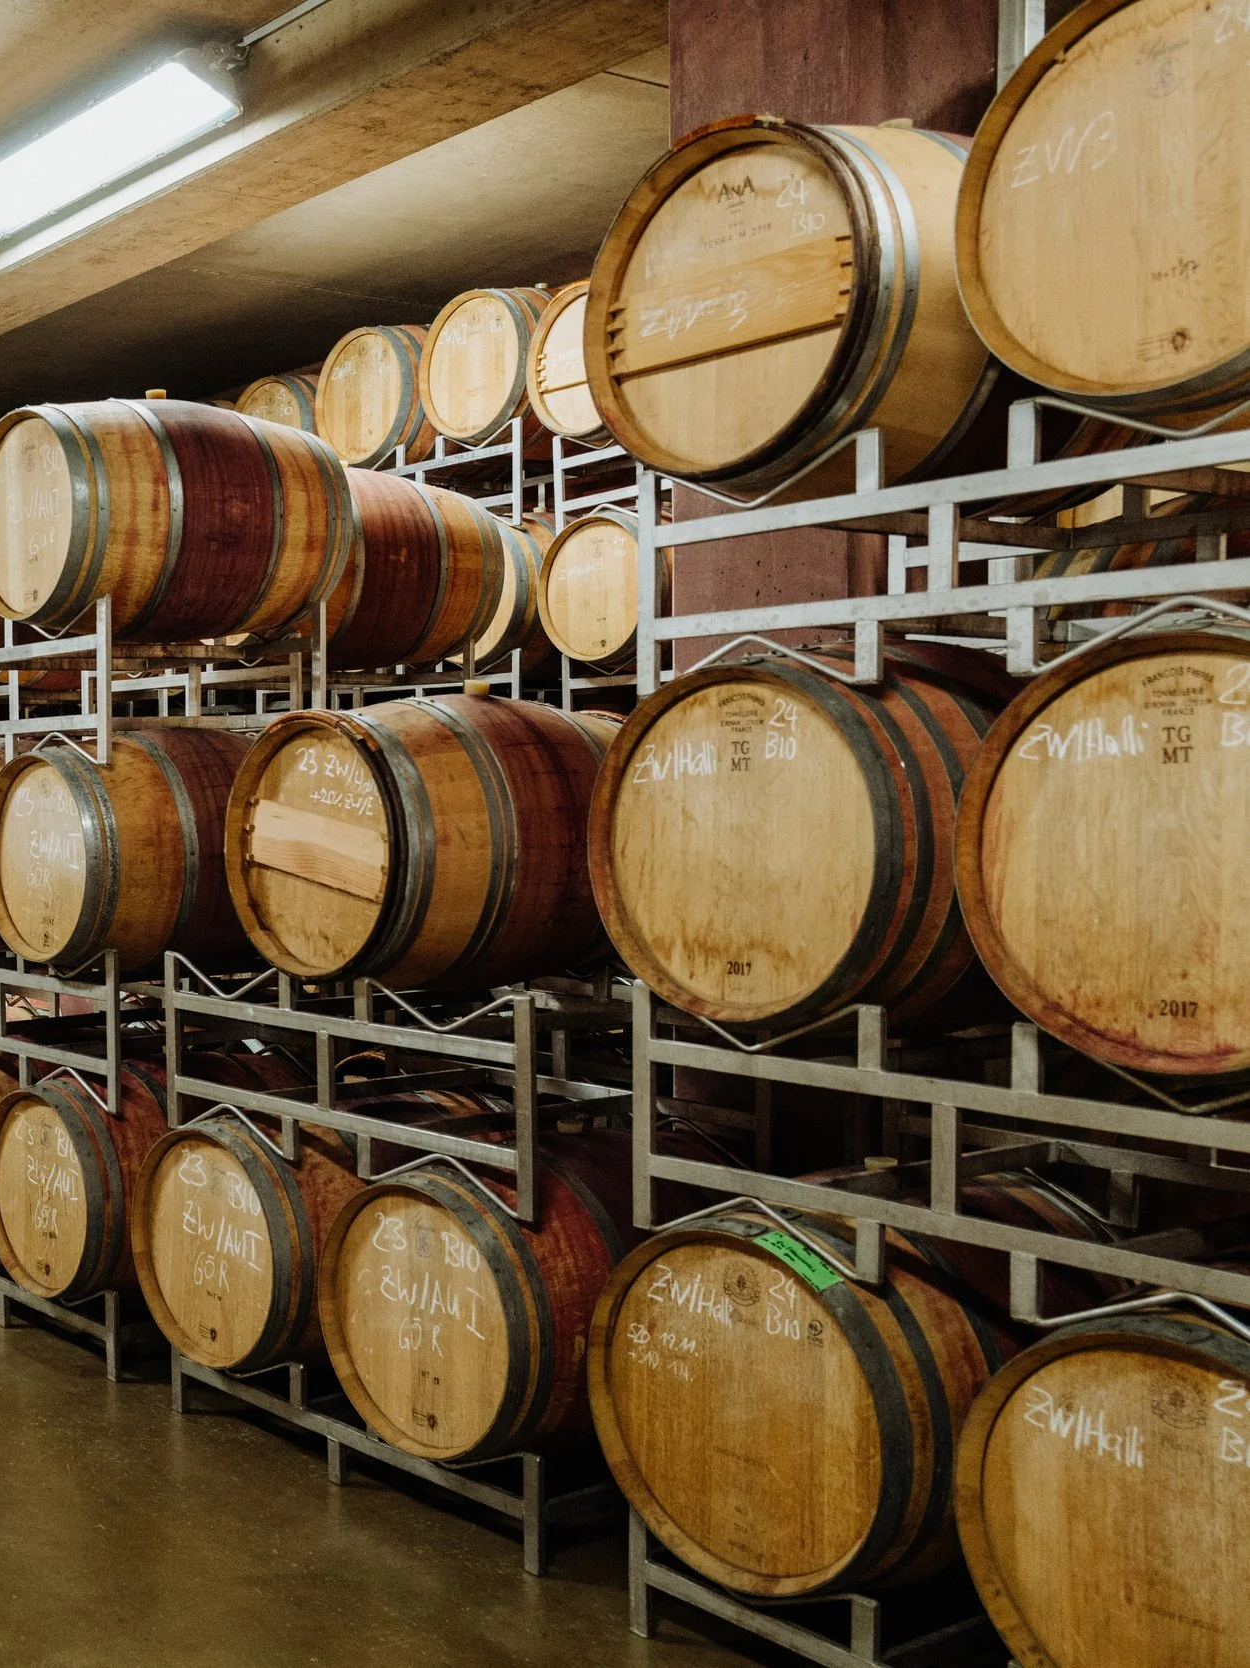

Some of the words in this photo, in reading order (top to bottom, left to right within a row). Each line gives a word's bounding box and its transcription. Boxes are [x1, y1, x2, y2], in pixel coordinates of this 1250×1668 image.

[768, 698, 799, 733] 24
[1162, 726, 1191, 743] TG
[731, 741, 750, 755] TG
[1162, 747, 1194, 764] MT
[295, 747, 318, 776] 23
[730, 757, 751, 771] MT
[726, 960, 752, 976] 2017
[1159, 999, 1198, 1018] 2017
[179, 1149, 207, 1187] 23
[372, 1211, 407, 1252] 23
[441, 1231, 481, 1273] BIO
[768, 1268, 797, 1309] 24
